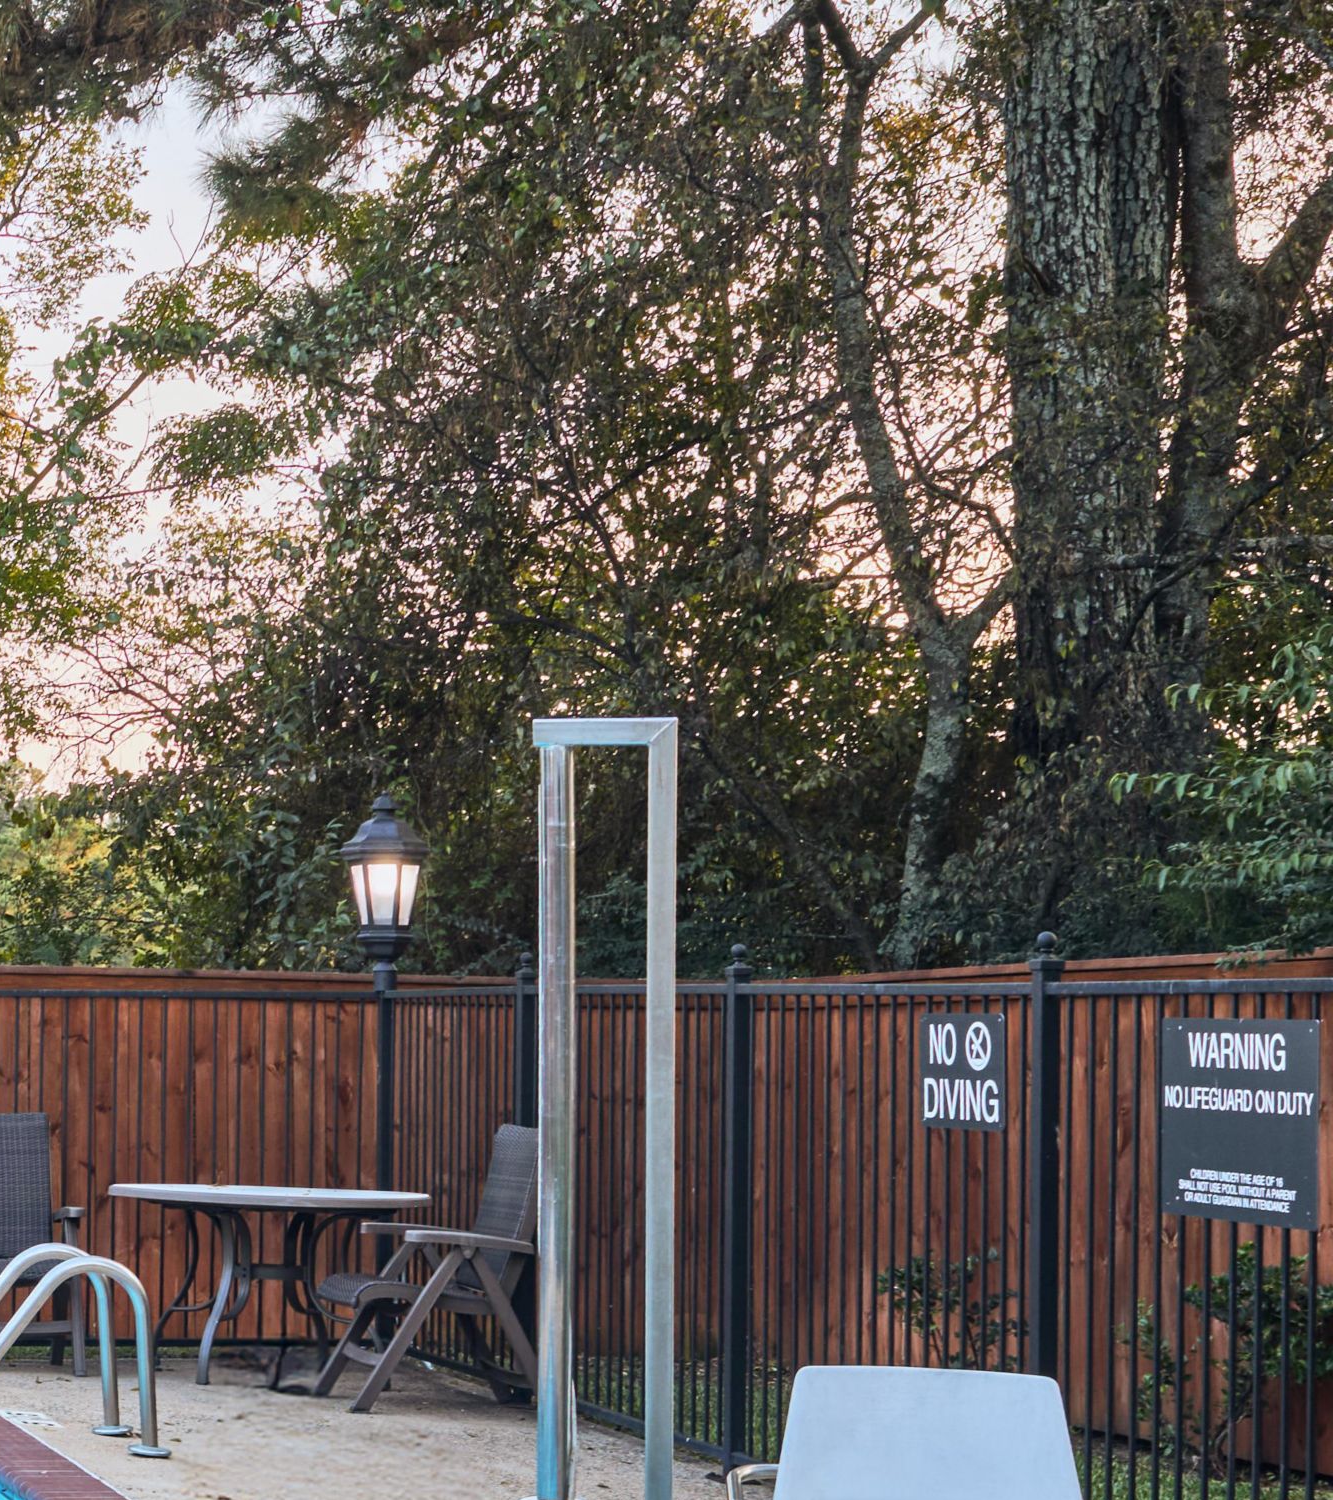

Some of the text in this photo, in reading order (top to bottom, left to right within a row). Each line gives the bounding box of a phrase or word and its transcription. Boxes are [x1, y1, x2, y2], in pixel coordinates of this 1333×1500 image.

[929, 1023, 957, 1066] NO
[1188, 1032, 1286, 1071] WARNING
[924, 1077, 1000, 1123] DIVING
[1164, 1085, 1314, 1116] NO LIFEGUARD ON DUTY
[1178, 1179, 1297, 1201] SHALL NOT USE POOL WITHOUT A PARENT
[1190, 1168, 1218, 1181] CHILDREN
[1218, 1170, 1239, 1183] UNDER
[1239, 1173, 1252, 1184] THE
[1252, 1174, 1266, 1186] AGE
[1266, 1175, 1276, 1187] OF
[1184, 1191, 1194, 1202] OR
[1194, 1192, 1212, 1204] ADULT
[1212, 1194, 1243, 1207] GUARDIAN
[1250, 1198, 1290, 1213] ATTENDANCE
